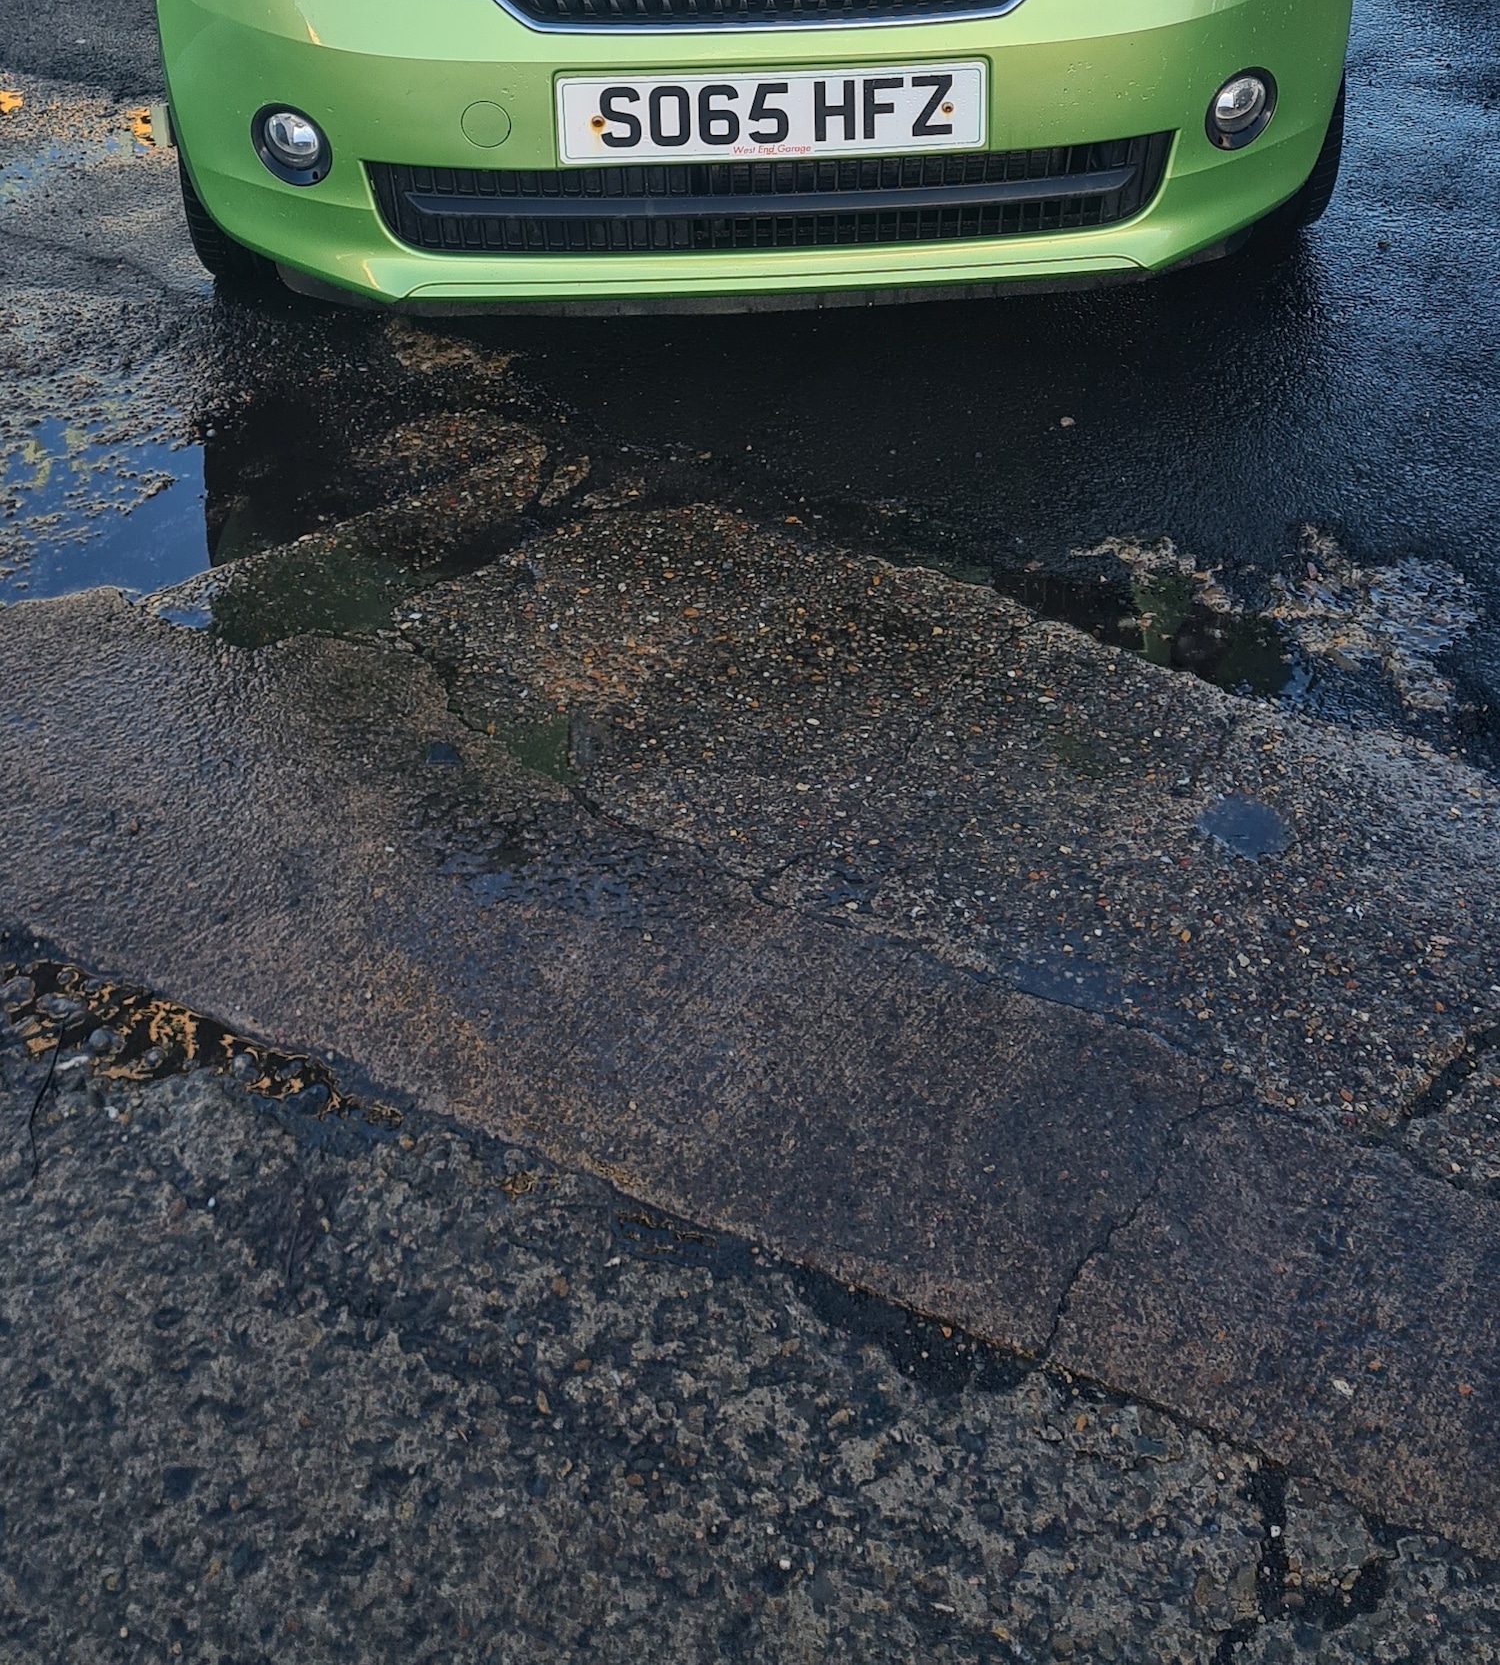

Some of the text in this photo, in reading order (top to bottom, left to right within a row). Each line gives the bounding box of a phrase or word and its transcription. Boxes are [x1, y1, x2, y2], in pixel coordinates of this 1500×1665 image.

[599, 74, 953, 148] SO65 HFZ
[733, 144, 812, 155] West End Garage
